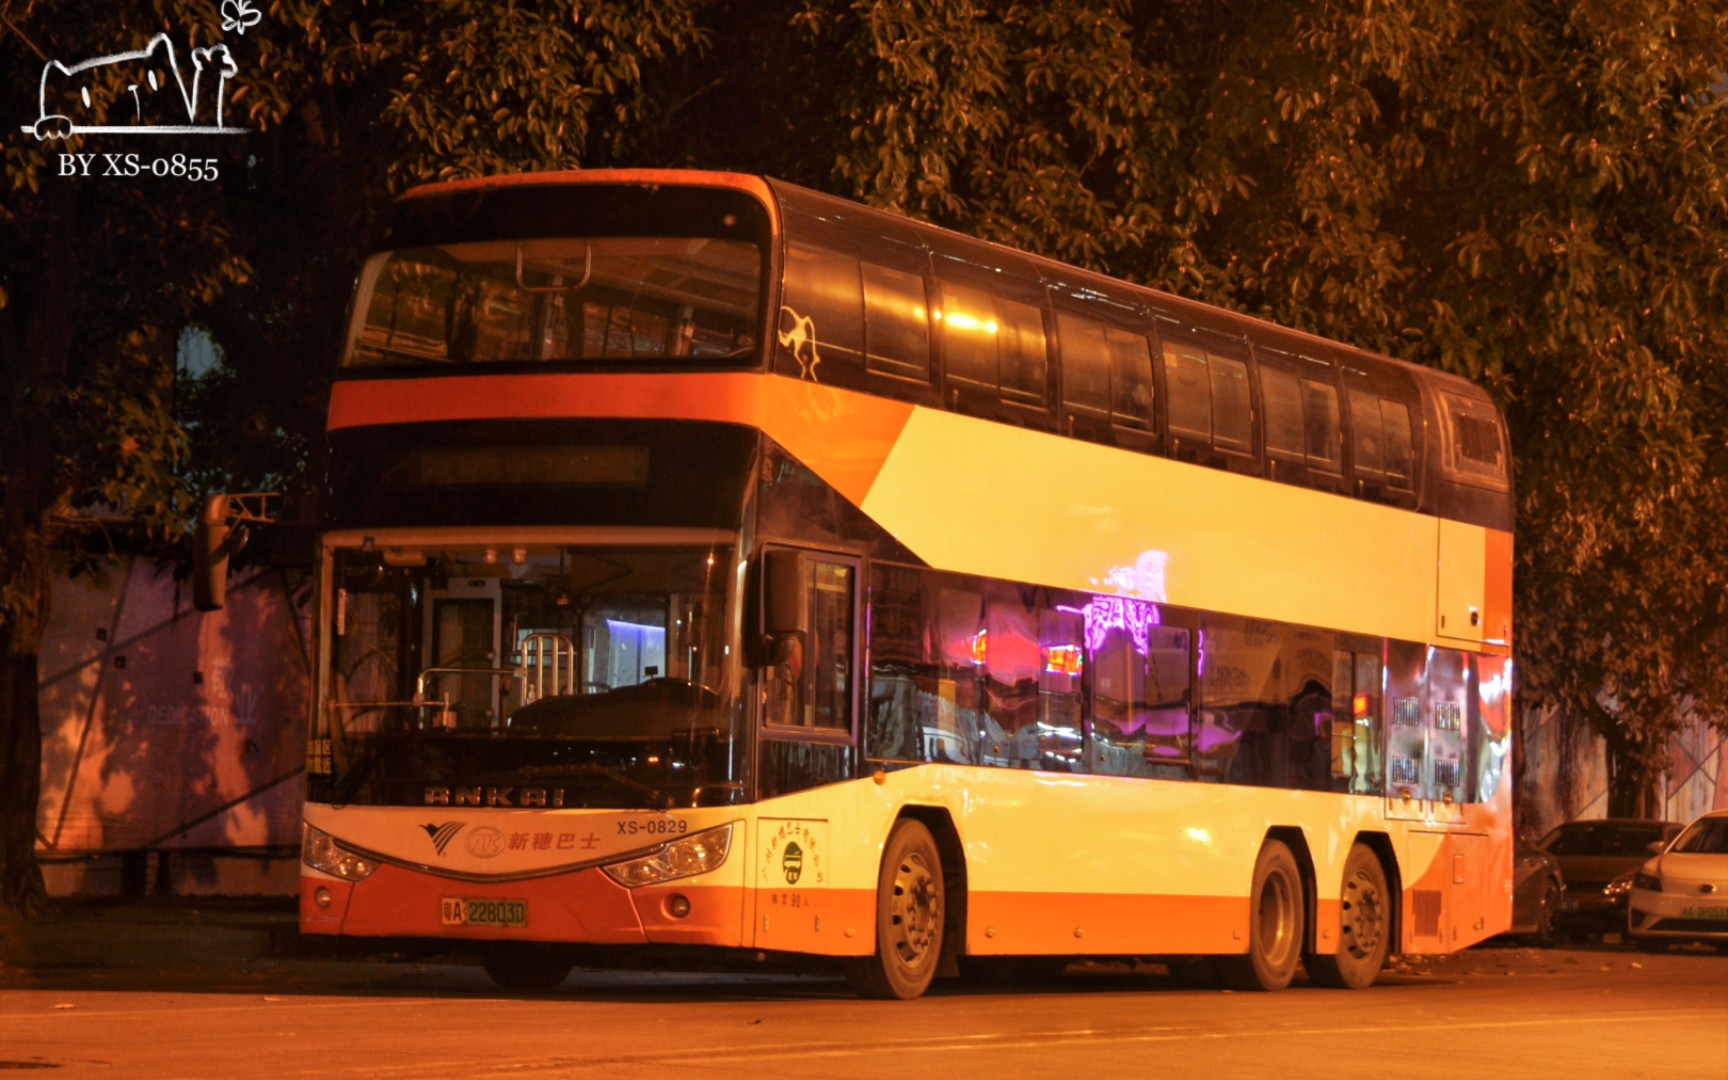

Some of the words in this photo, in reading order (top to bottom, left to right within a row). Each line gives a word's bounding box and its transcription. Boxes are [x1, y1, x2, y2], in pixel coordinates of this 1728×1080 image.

[149, 704, 228, 727] DEDICATION
[424, 786, 565, 807] ANKAI
[617, 819, 687, 835] XS-0829
[508, 832, 601, 850] 新穗巴士
